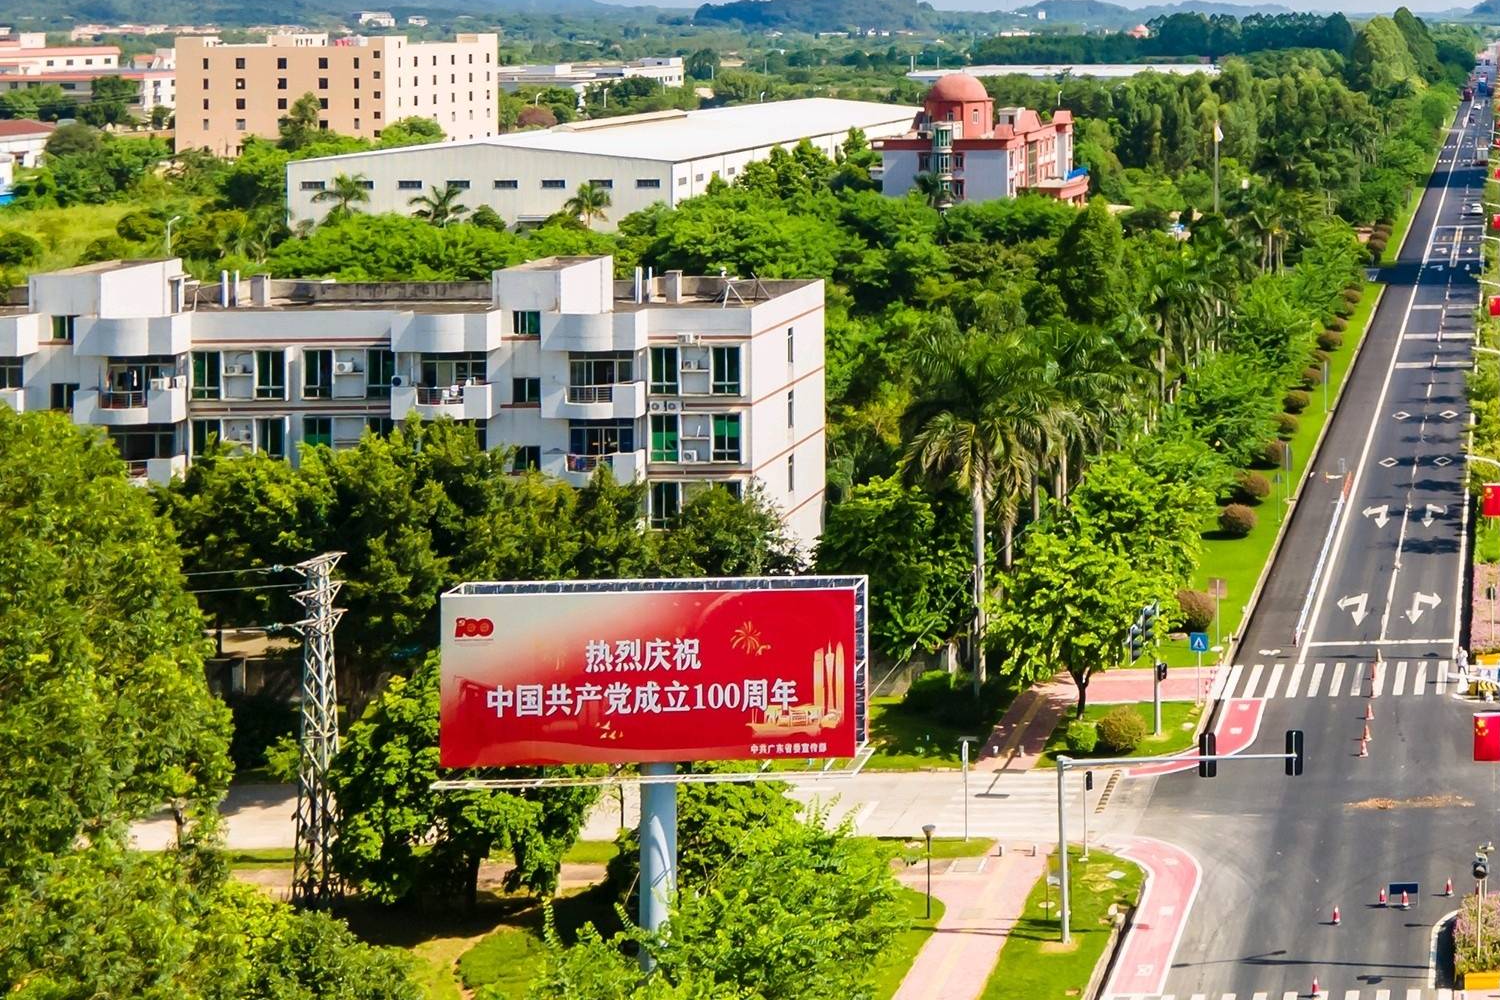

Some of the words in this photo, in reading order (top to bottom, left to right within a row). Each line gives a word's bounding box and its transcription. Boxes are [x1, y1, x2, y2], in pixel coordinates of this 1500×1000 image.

[455, 617, 494, 638] 100
[585, 638, 702, 673] 热烈庆祝
[486, 678, 799, 719] 中国共产党成立100周年
[750, 742, 827, 754] 中共广东省委宣传部
